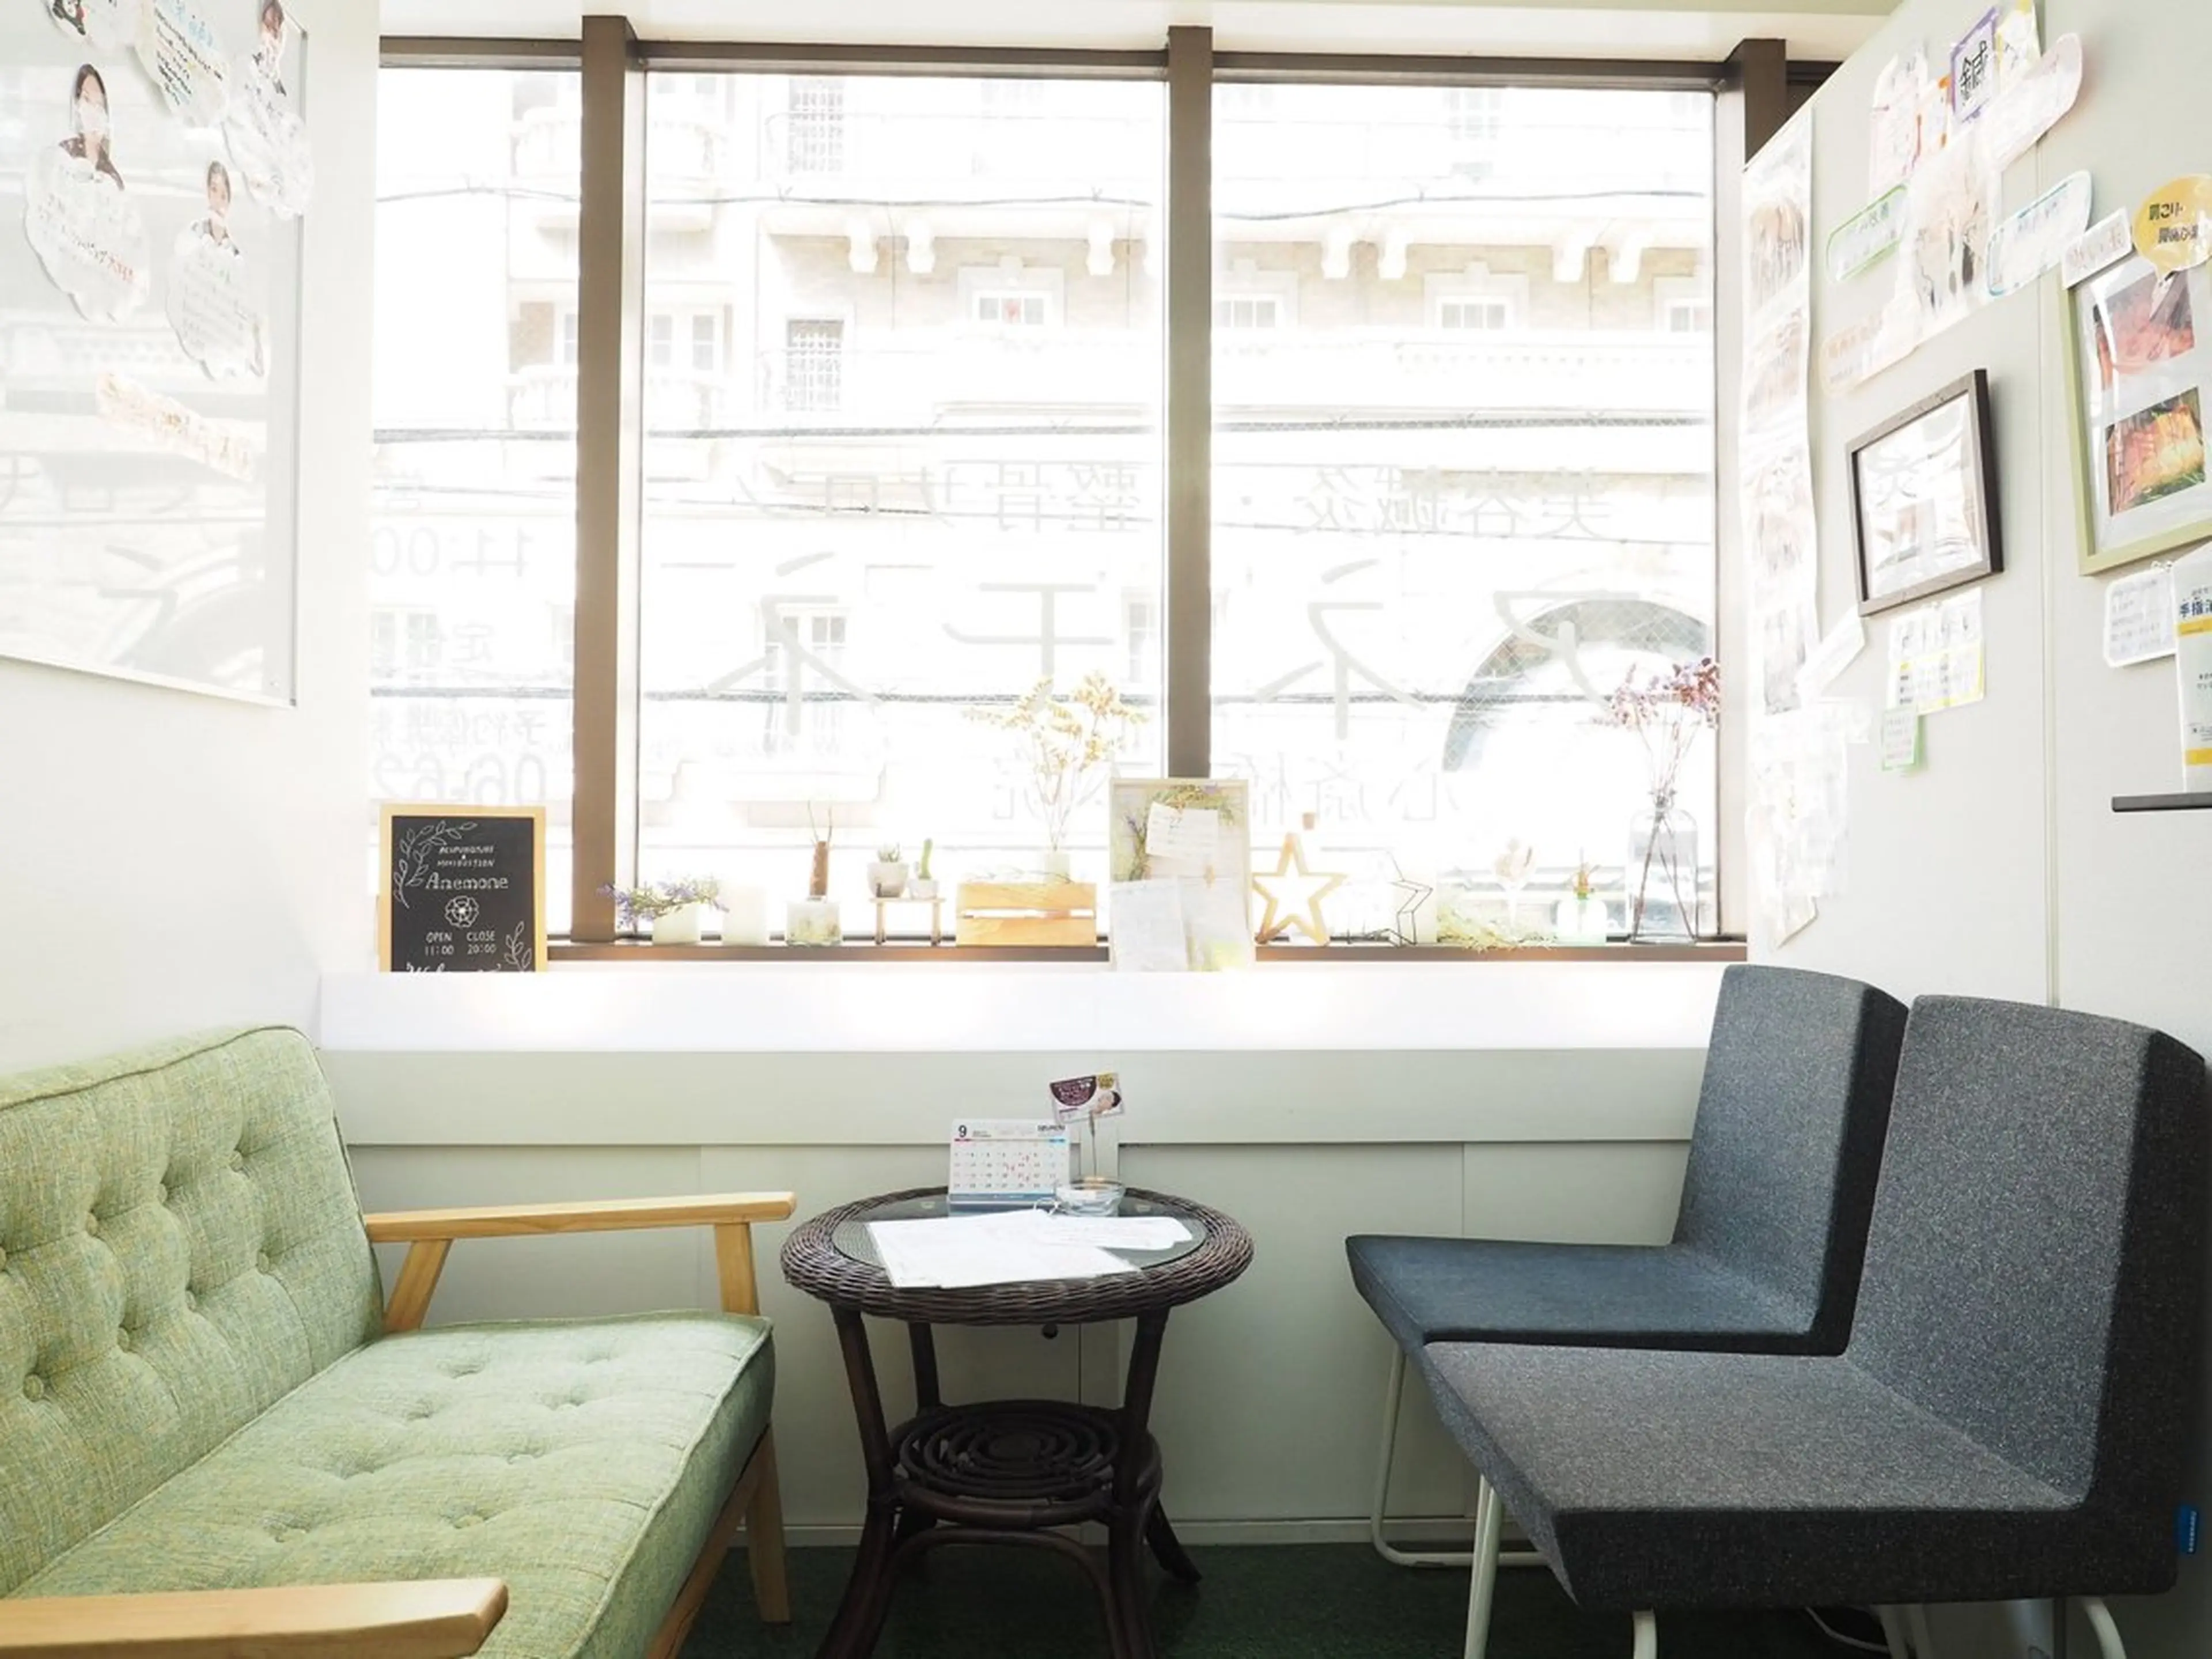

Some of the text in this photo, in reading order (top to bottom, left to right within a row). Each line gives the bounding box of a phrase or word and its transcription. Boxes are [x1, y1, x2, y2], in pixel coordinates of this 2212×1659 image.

[425, 871, 509, 891] Anemone
[425, 930, 496, 944] OPEN CLOSE
[425, 943, 497, 957] 11:00 20:00
[958, 1124, 967, 1138] 9
